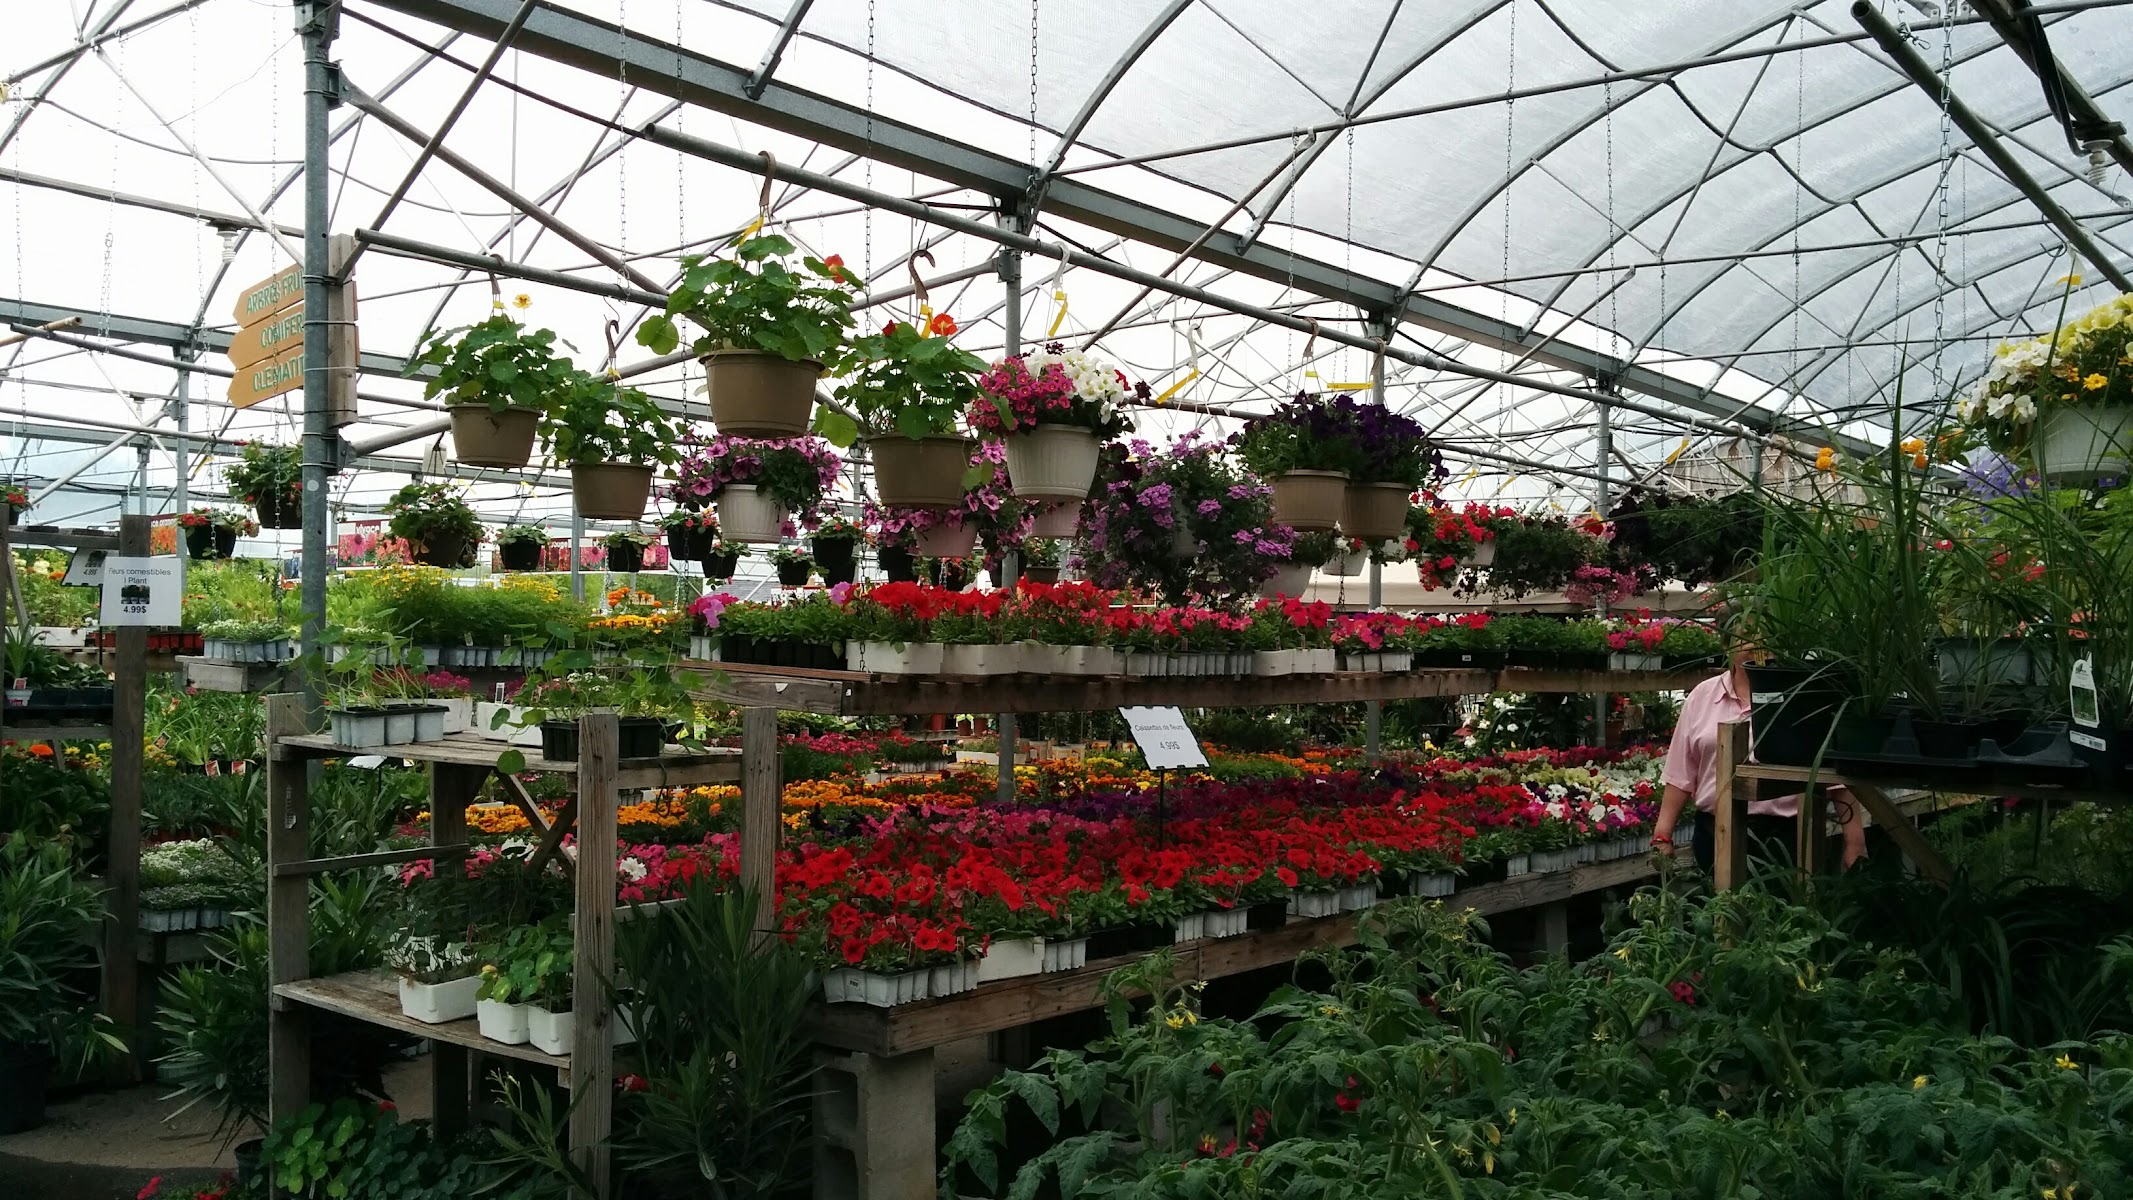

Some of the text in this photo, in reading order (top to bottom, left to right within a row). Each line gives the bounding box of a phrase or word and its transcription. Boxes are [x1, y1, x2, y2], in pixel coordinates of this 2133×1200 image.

[247, 280, 282, 315] ARBRES
[125, 568, 171, 576] comestibles
[128, 576, 147, 584] Plant
[123, 605, 147, 614] 4.99$
